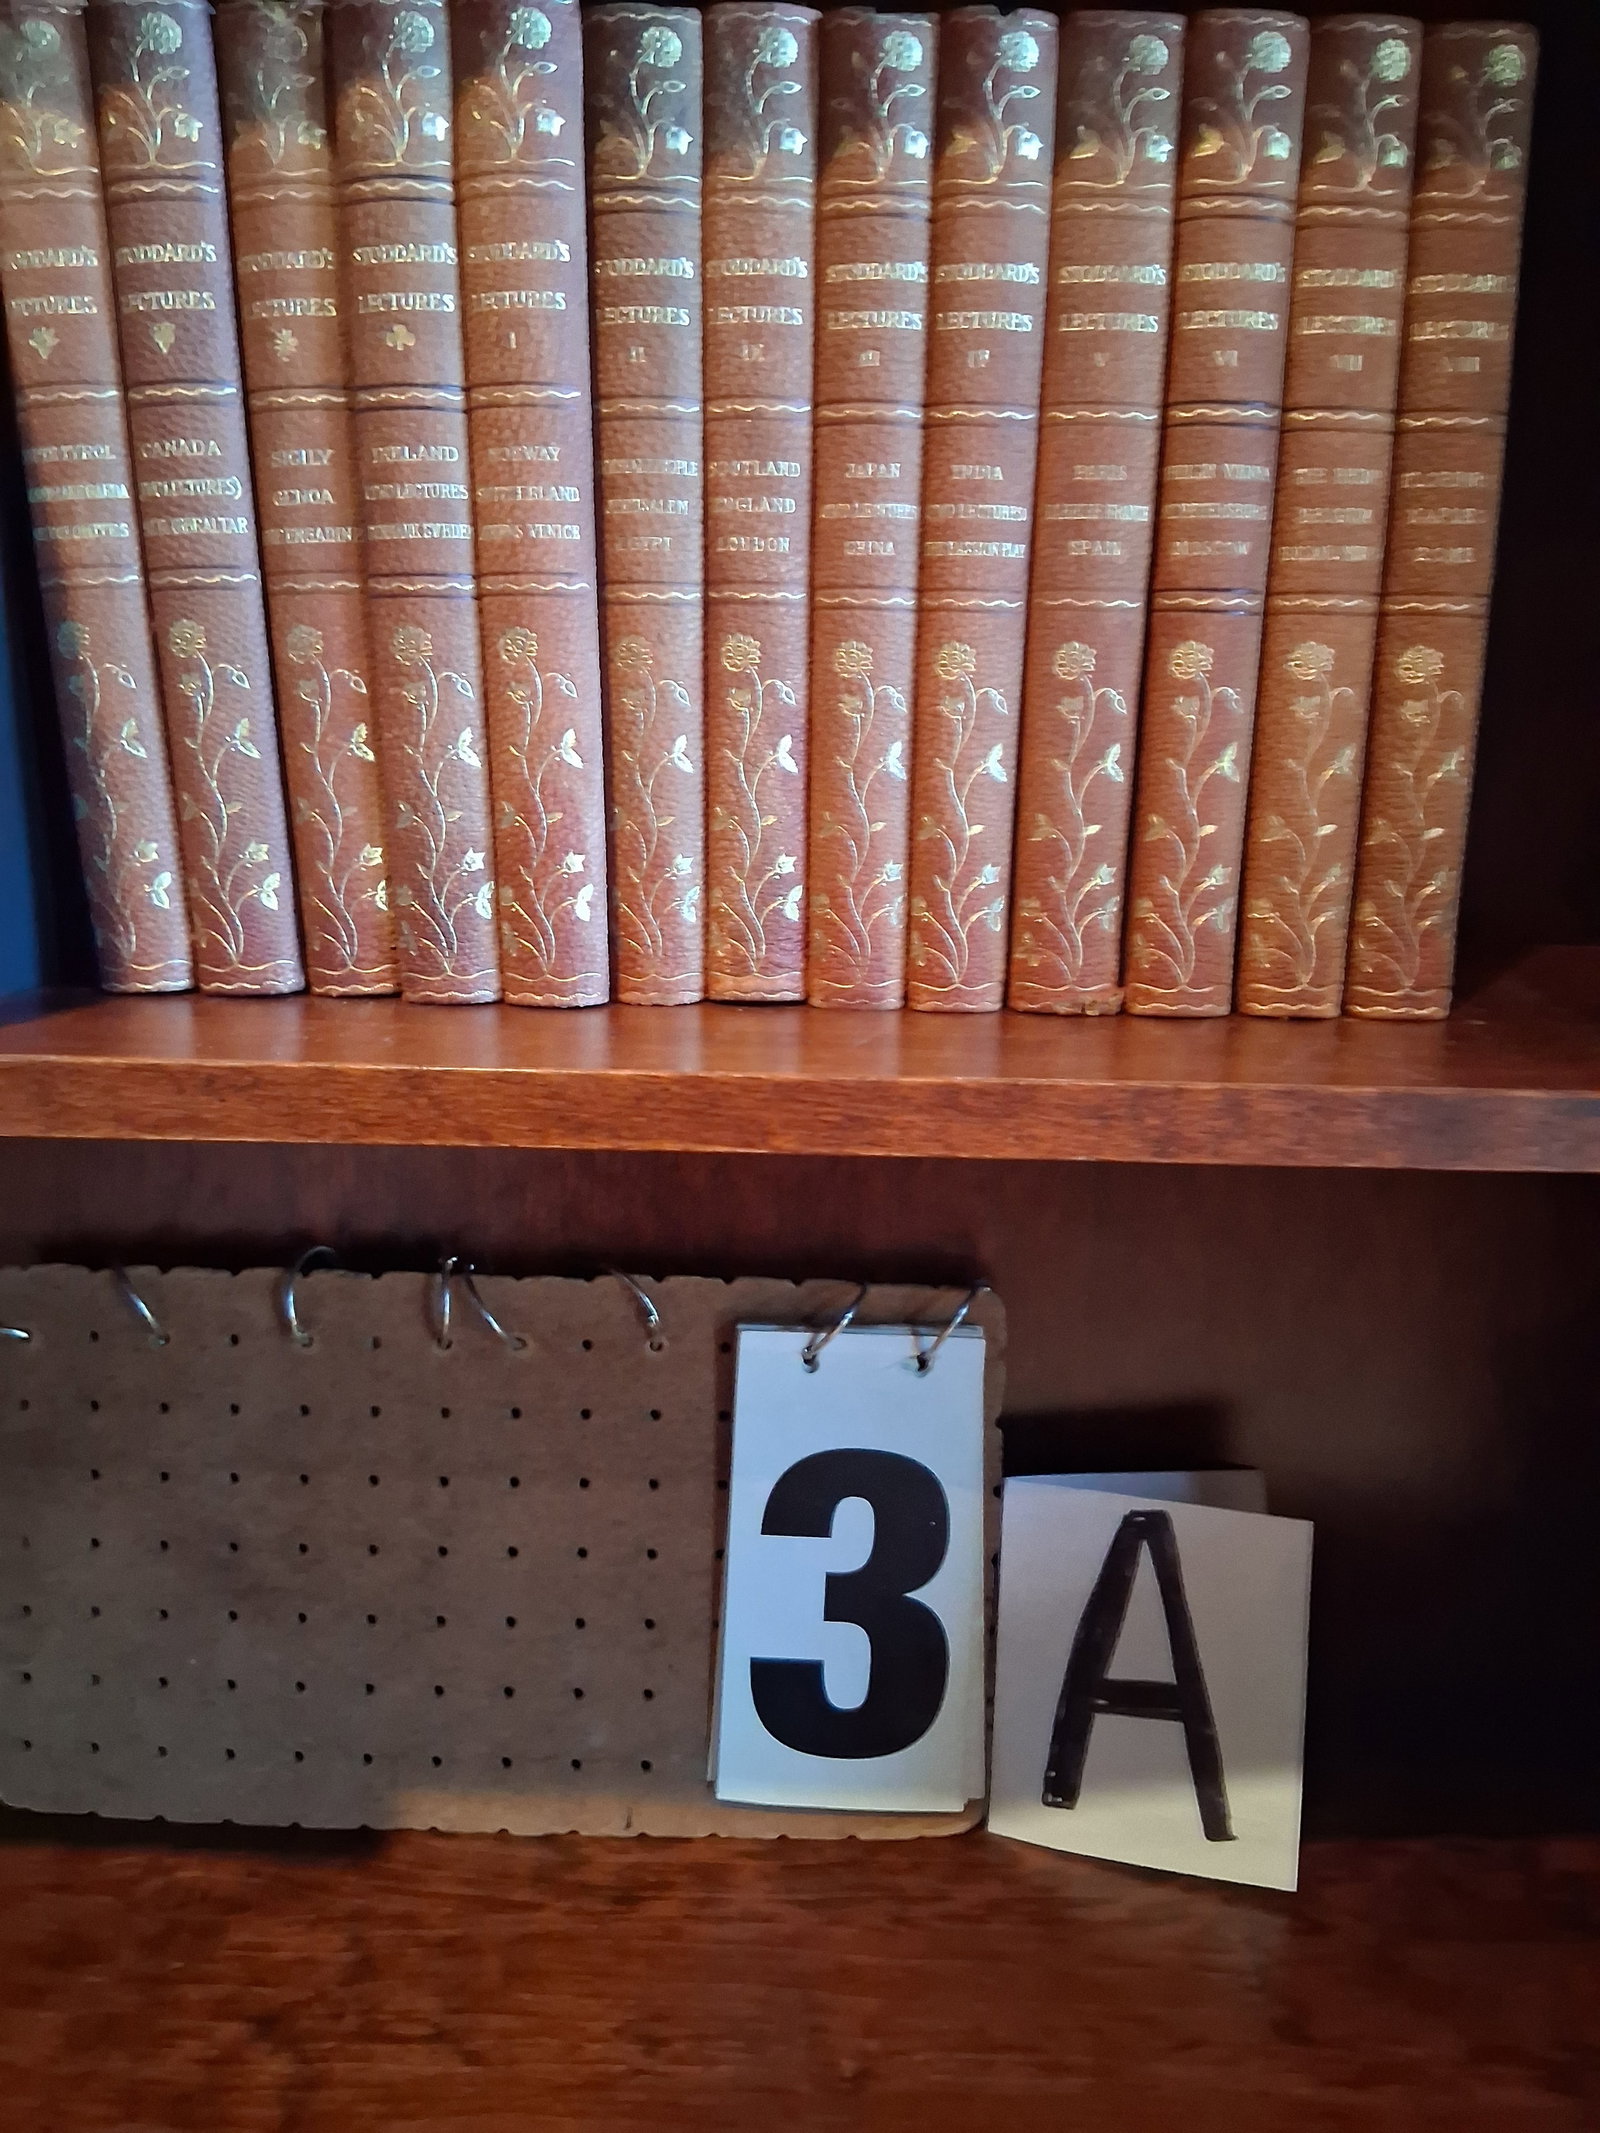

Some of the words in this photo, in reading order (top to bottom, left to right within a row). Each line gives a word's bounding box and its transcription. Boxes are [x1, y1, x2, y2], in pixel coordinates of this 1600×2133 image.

[141, 438, 222, 458] CANADA
[750, 1448, 950, 1759] 3
[1042, 1509, 1238, 1842] A
